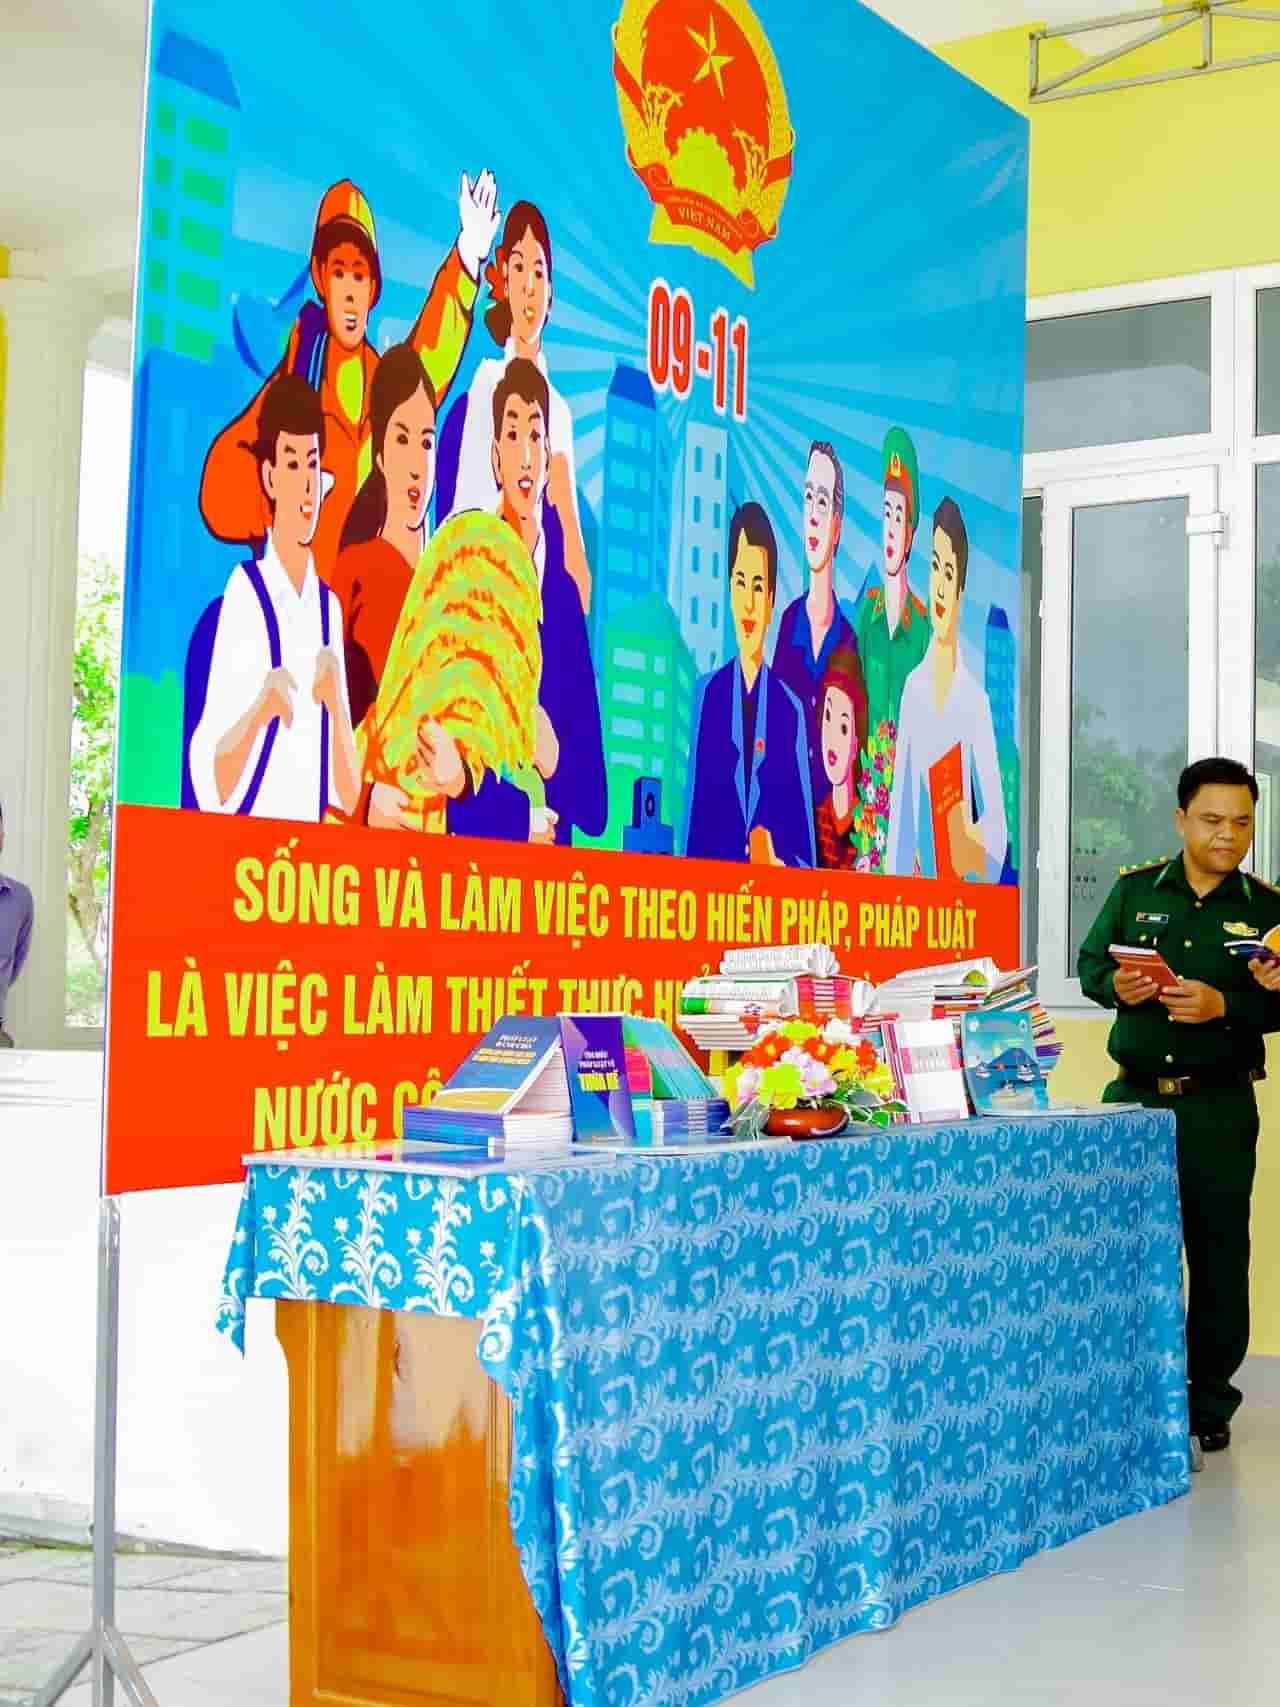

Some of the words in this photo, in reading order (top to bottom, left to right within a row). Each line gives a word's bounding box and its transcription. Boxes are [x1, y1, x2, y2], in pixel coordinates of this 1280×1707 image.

[647, 277, 748, 424] 09-11
[234, 838, 360, 925] SỐNG
[374, 857, 427, 928] VÀ
[439, 863, 522, 933] LÀM
[534, 871, 609, 949] VIỆC
[620, 887, 697, 941] THEO
[706, 880, 772, 944] HIẾN
[781, 890, 851, 951] PHÁP,
[859, 896, 920, 948] PHÁP
[927, 899, 977, 959] LUẬT
[146, 957, 208, 1037] LÀ
[225, 960, 328, 1050] VIỆC
[343, 961, 432, 1034] LÀM
[446, 959, 548, 1033] THIẾT
[253, 1070, 377, 1151] NƯỚC
